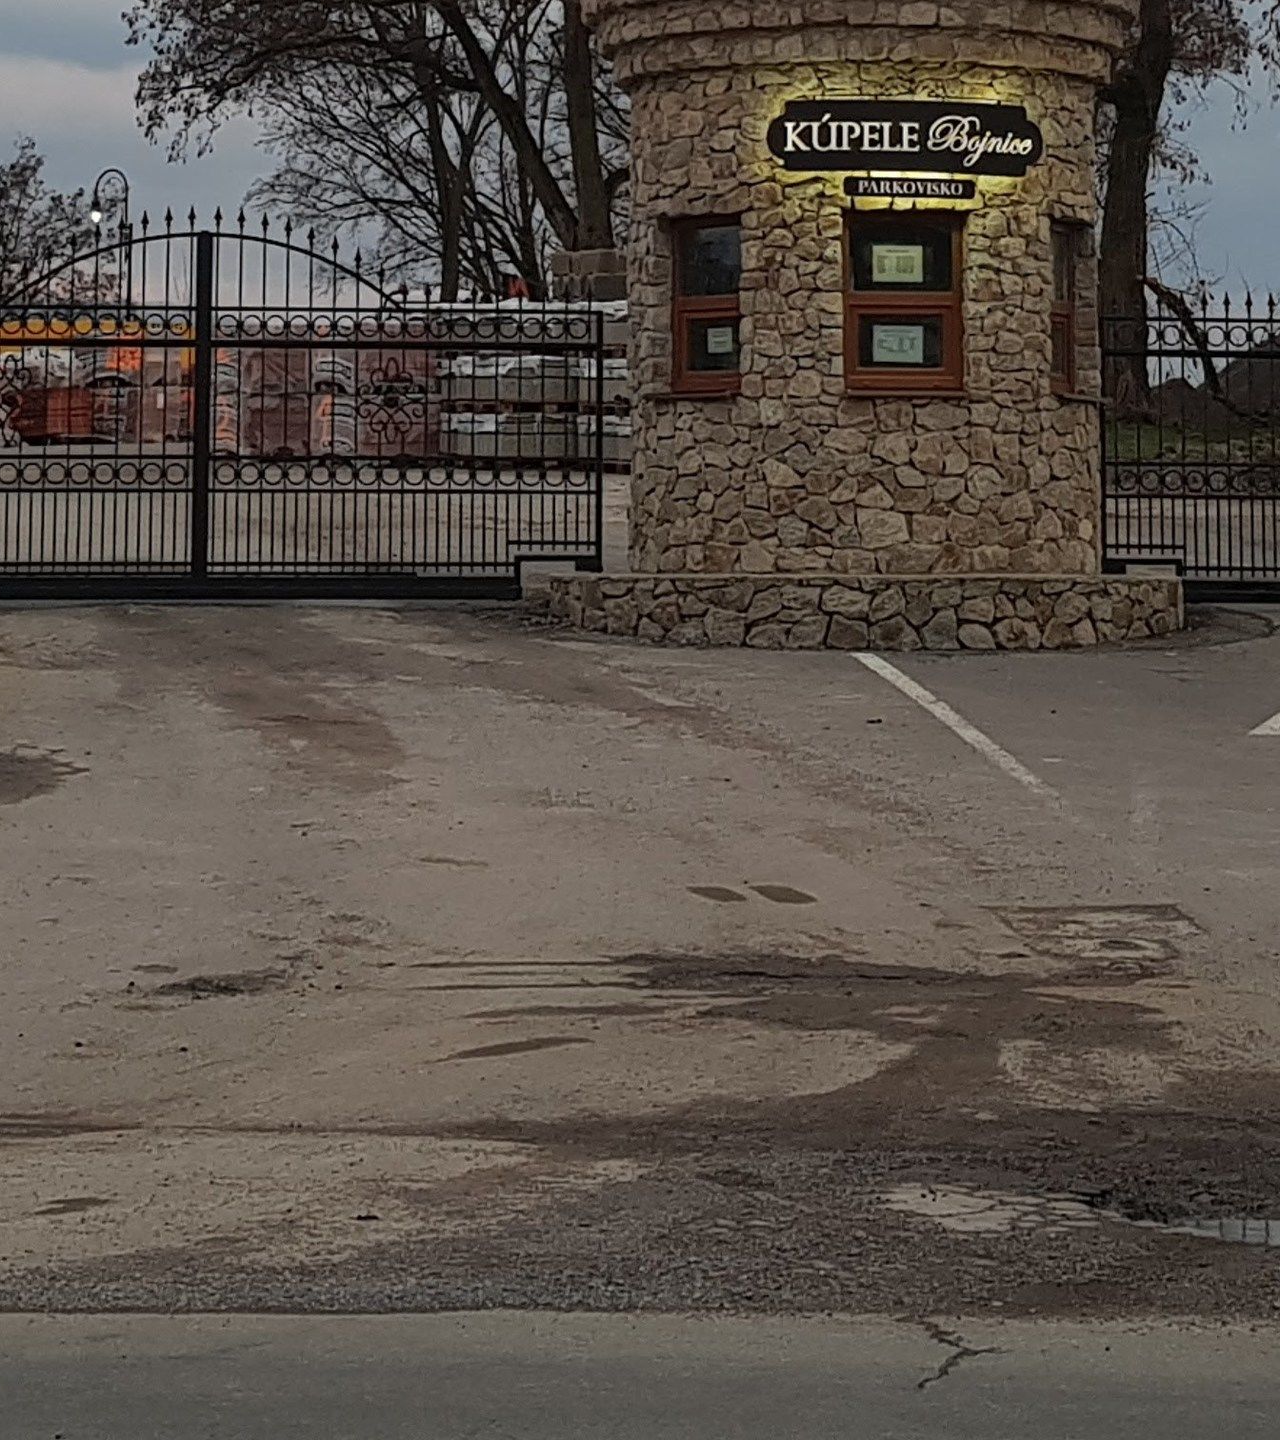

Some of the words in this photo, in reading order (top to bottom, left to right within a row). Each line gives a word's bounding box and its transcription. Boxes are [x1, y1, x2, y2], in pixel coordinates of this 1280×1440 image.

[784, 113, 920, 152] KÚPELE
[927, 115, 1033, 167] Bojnice
[858, 179, 963, 196] PARKOVISKO
